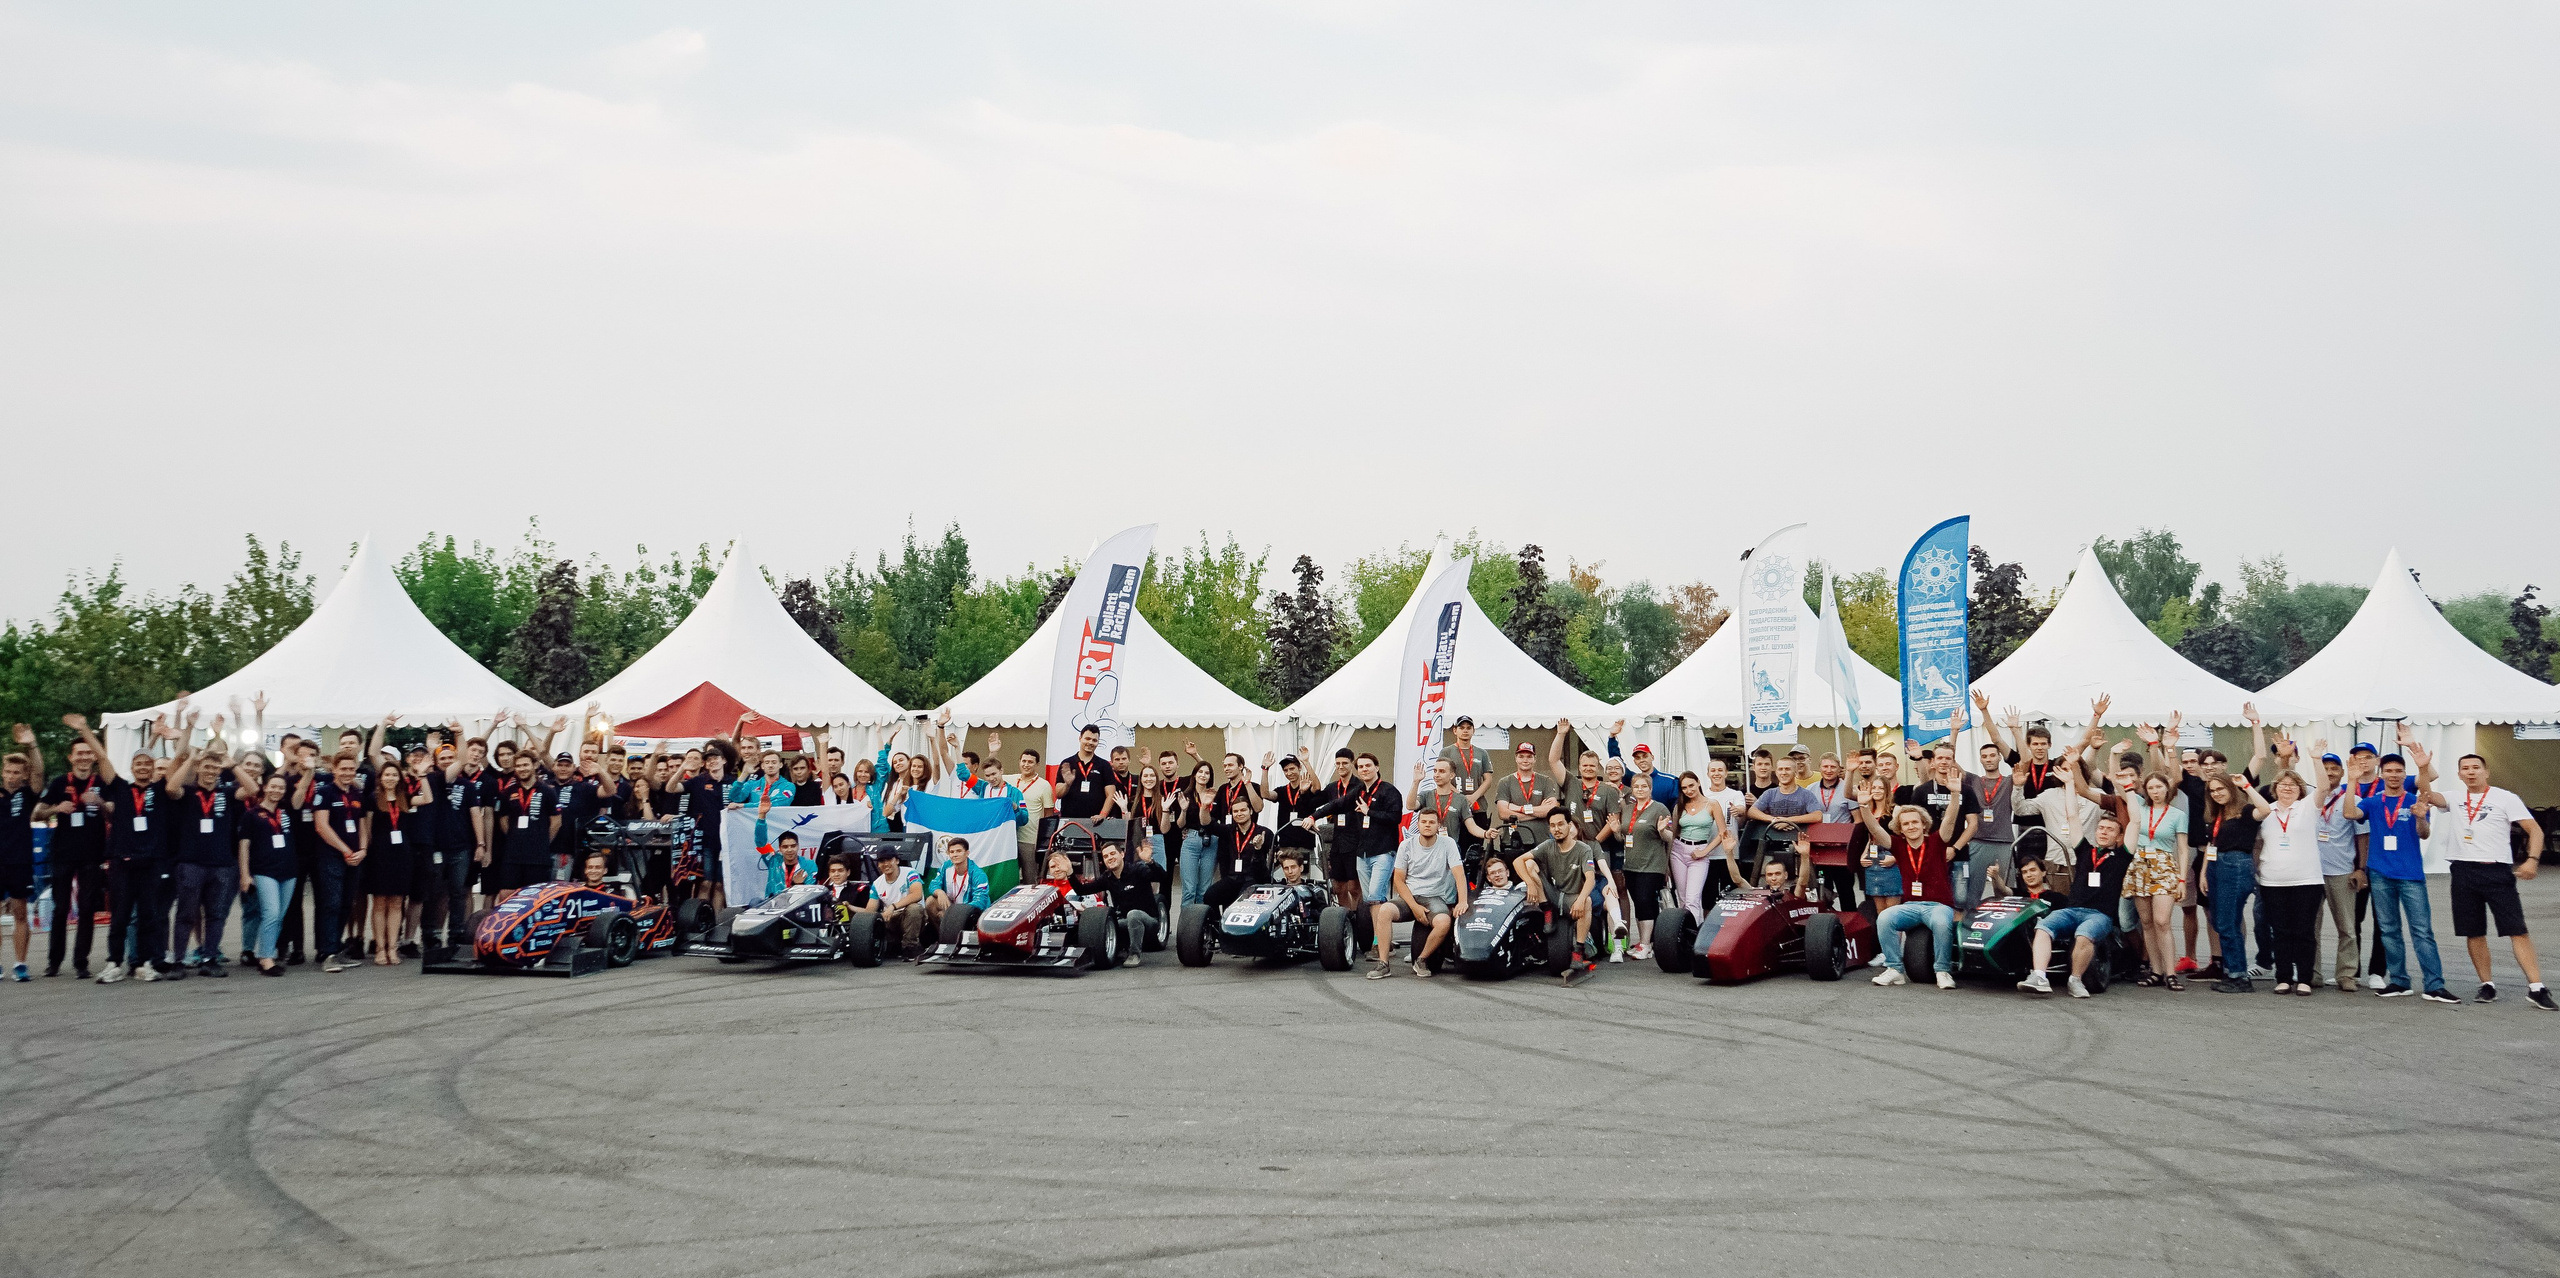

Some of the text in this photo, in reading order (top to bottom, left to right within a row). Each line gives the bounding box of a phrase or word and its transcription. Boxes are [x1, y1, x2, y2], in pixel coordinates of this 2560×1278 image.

[1098, 592, 1118, 638] Togliatti
[1110, 568, 1137, 640] Racing Team
[1448, 604, 1461, 636] Team
[1076, 635, 1113, 698] TRT
[1419, 680, 1444, 744] TRT
[1925, 719, 1951, 728] БГТУ
[1757, 722, 1779, 731] БГТУ
[566, 898, 582, 919] 21
[1035, 891, 1058, 916] TOGLIATTI
[1975, 911, 2007, 919] 78
[1229, 914, 1255, 924] 63
[1845, 937, 1858, 960] 31
